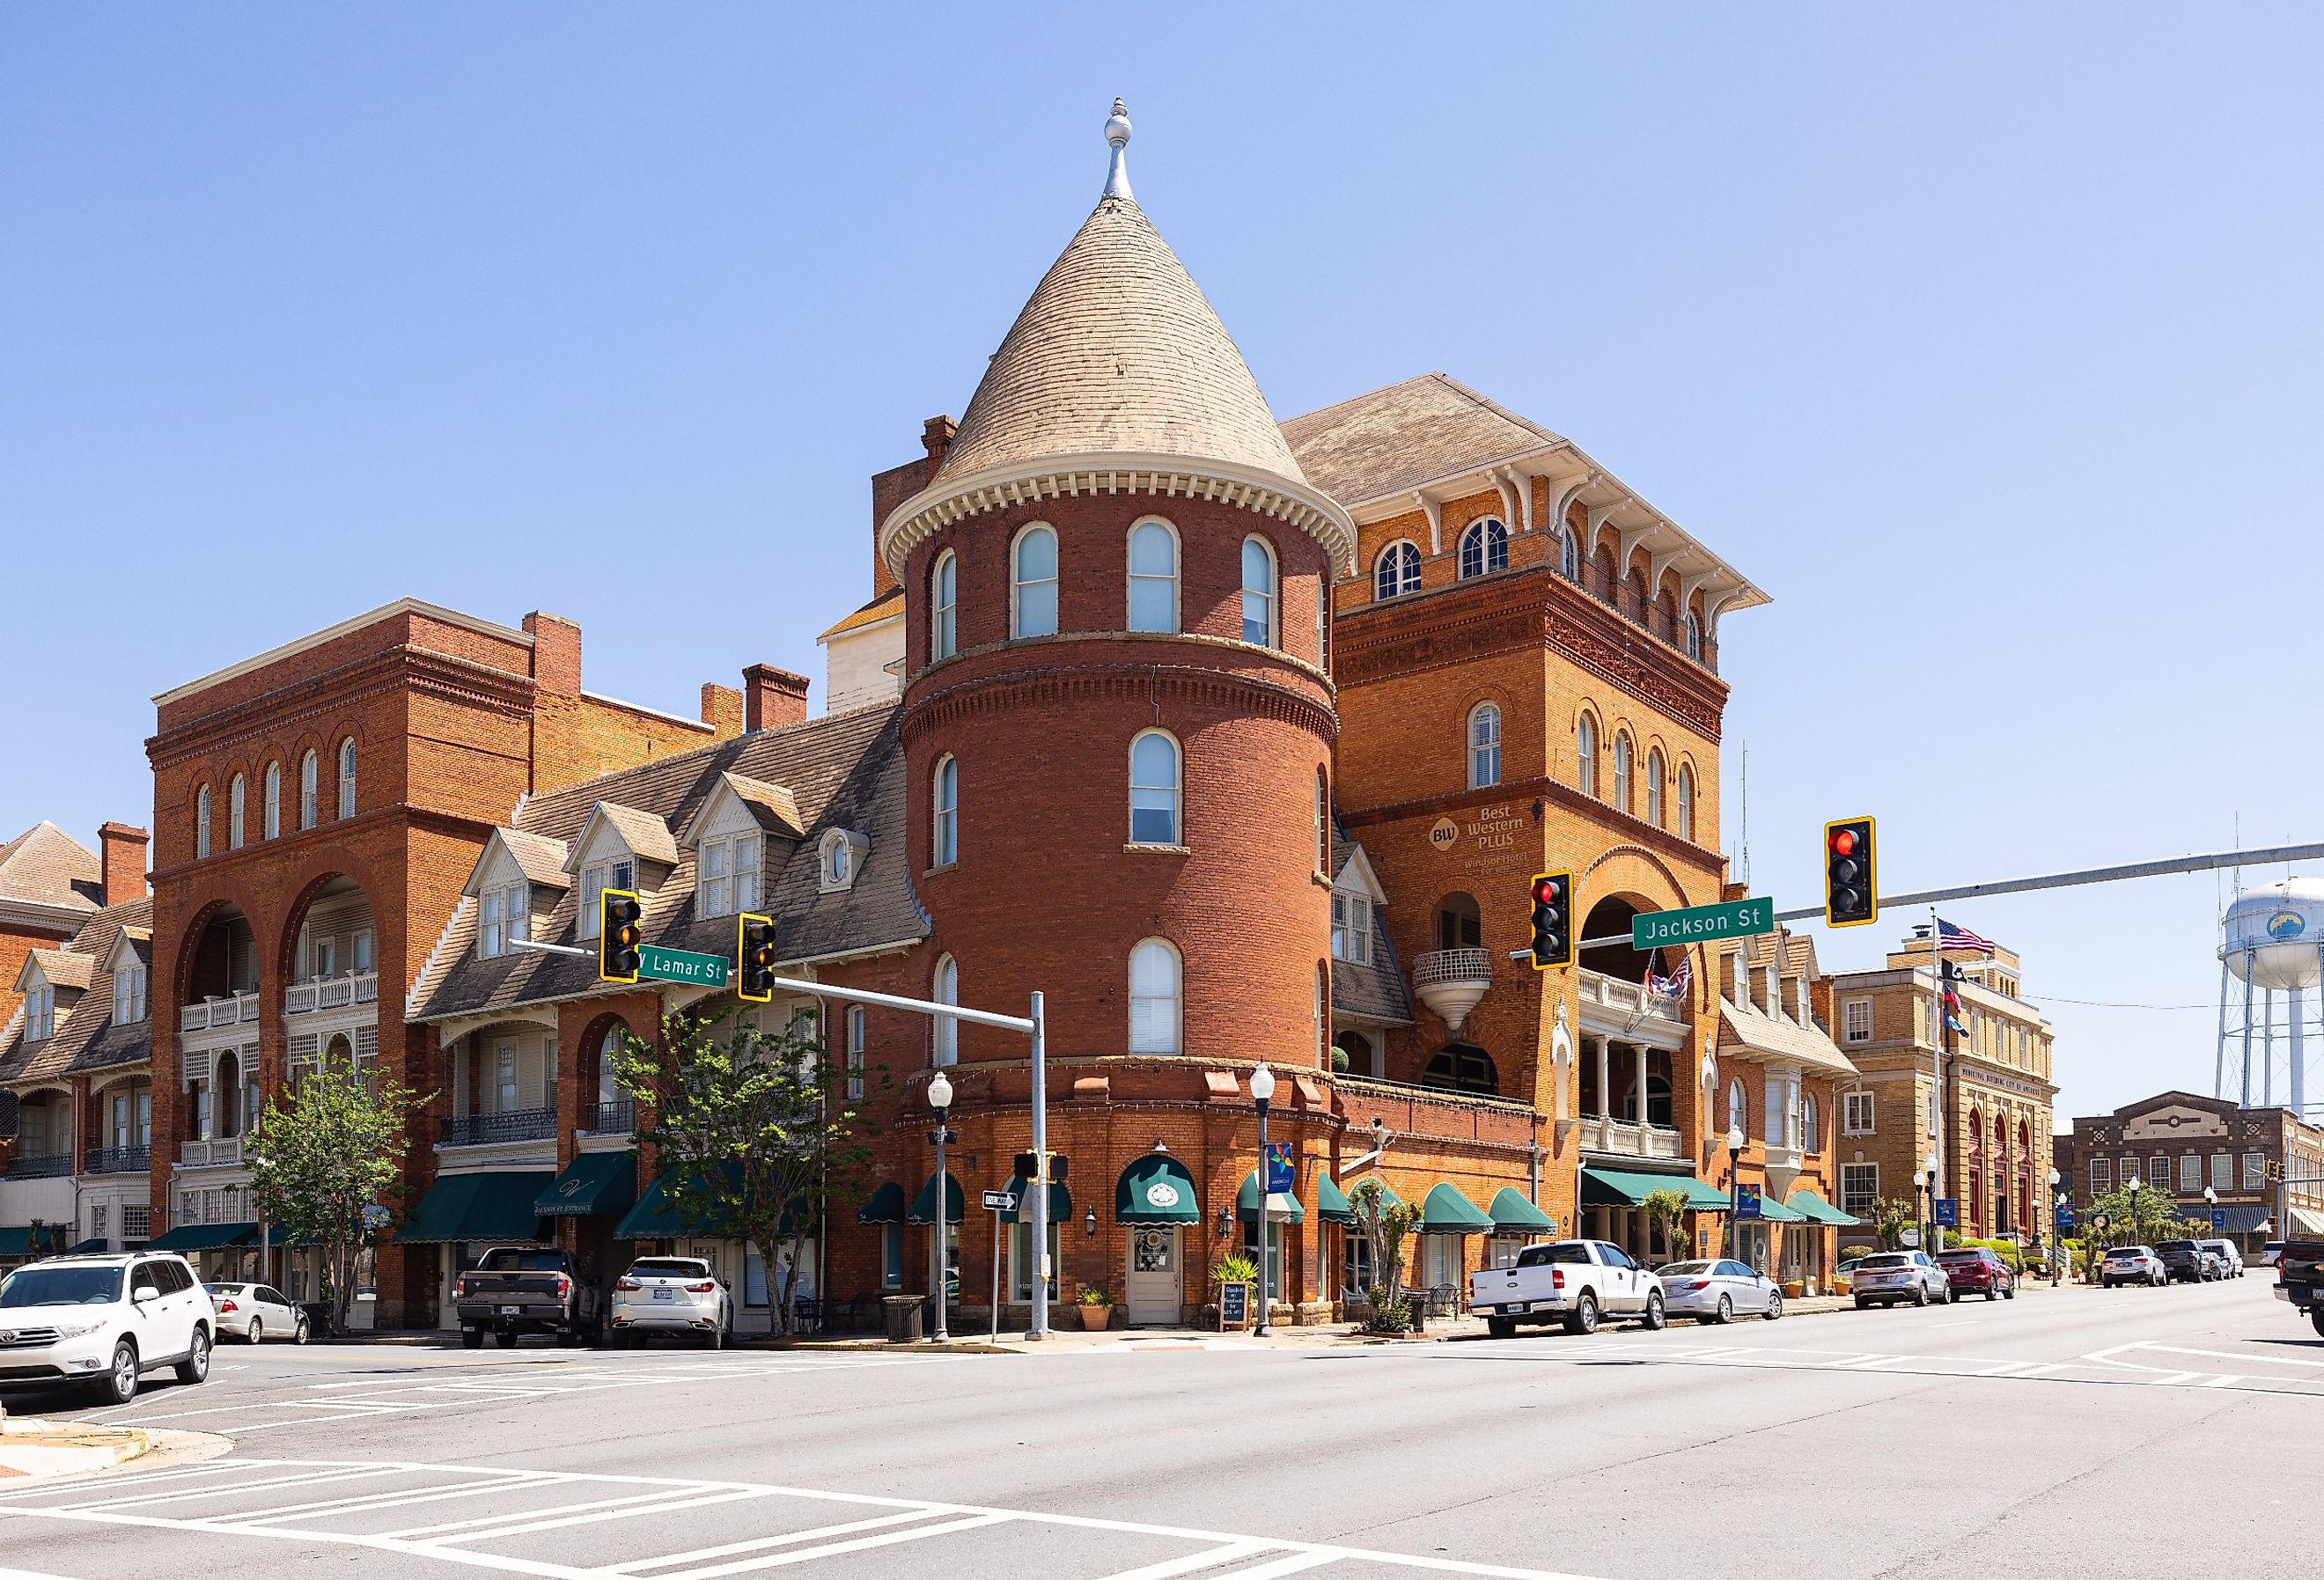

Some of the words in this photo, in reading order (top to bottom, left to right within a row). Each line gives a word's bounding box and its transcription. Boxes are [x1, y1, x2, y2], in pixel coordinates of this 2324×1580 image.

[1481, 806, 1511, 821] Best
[1433, 827, 1455, 842] BW
[1467, 818, 1524, 836] Western
[1478, 833, 1513, 850] PLUS
[1465, 856, 1500, 869] Windsor
[1503, 852, 1527, 864] Hotel
[1645, 915, 1728, 940] Jackson
[1738, 908, 1761, 927] St
[653, 955, 701, 976] Lamar
[705, 963, 722, 979] St
[1962, 1068, 1985, 1082] MUNICIPAL
[1986, 1074, 2005, 1086] BUILDING
